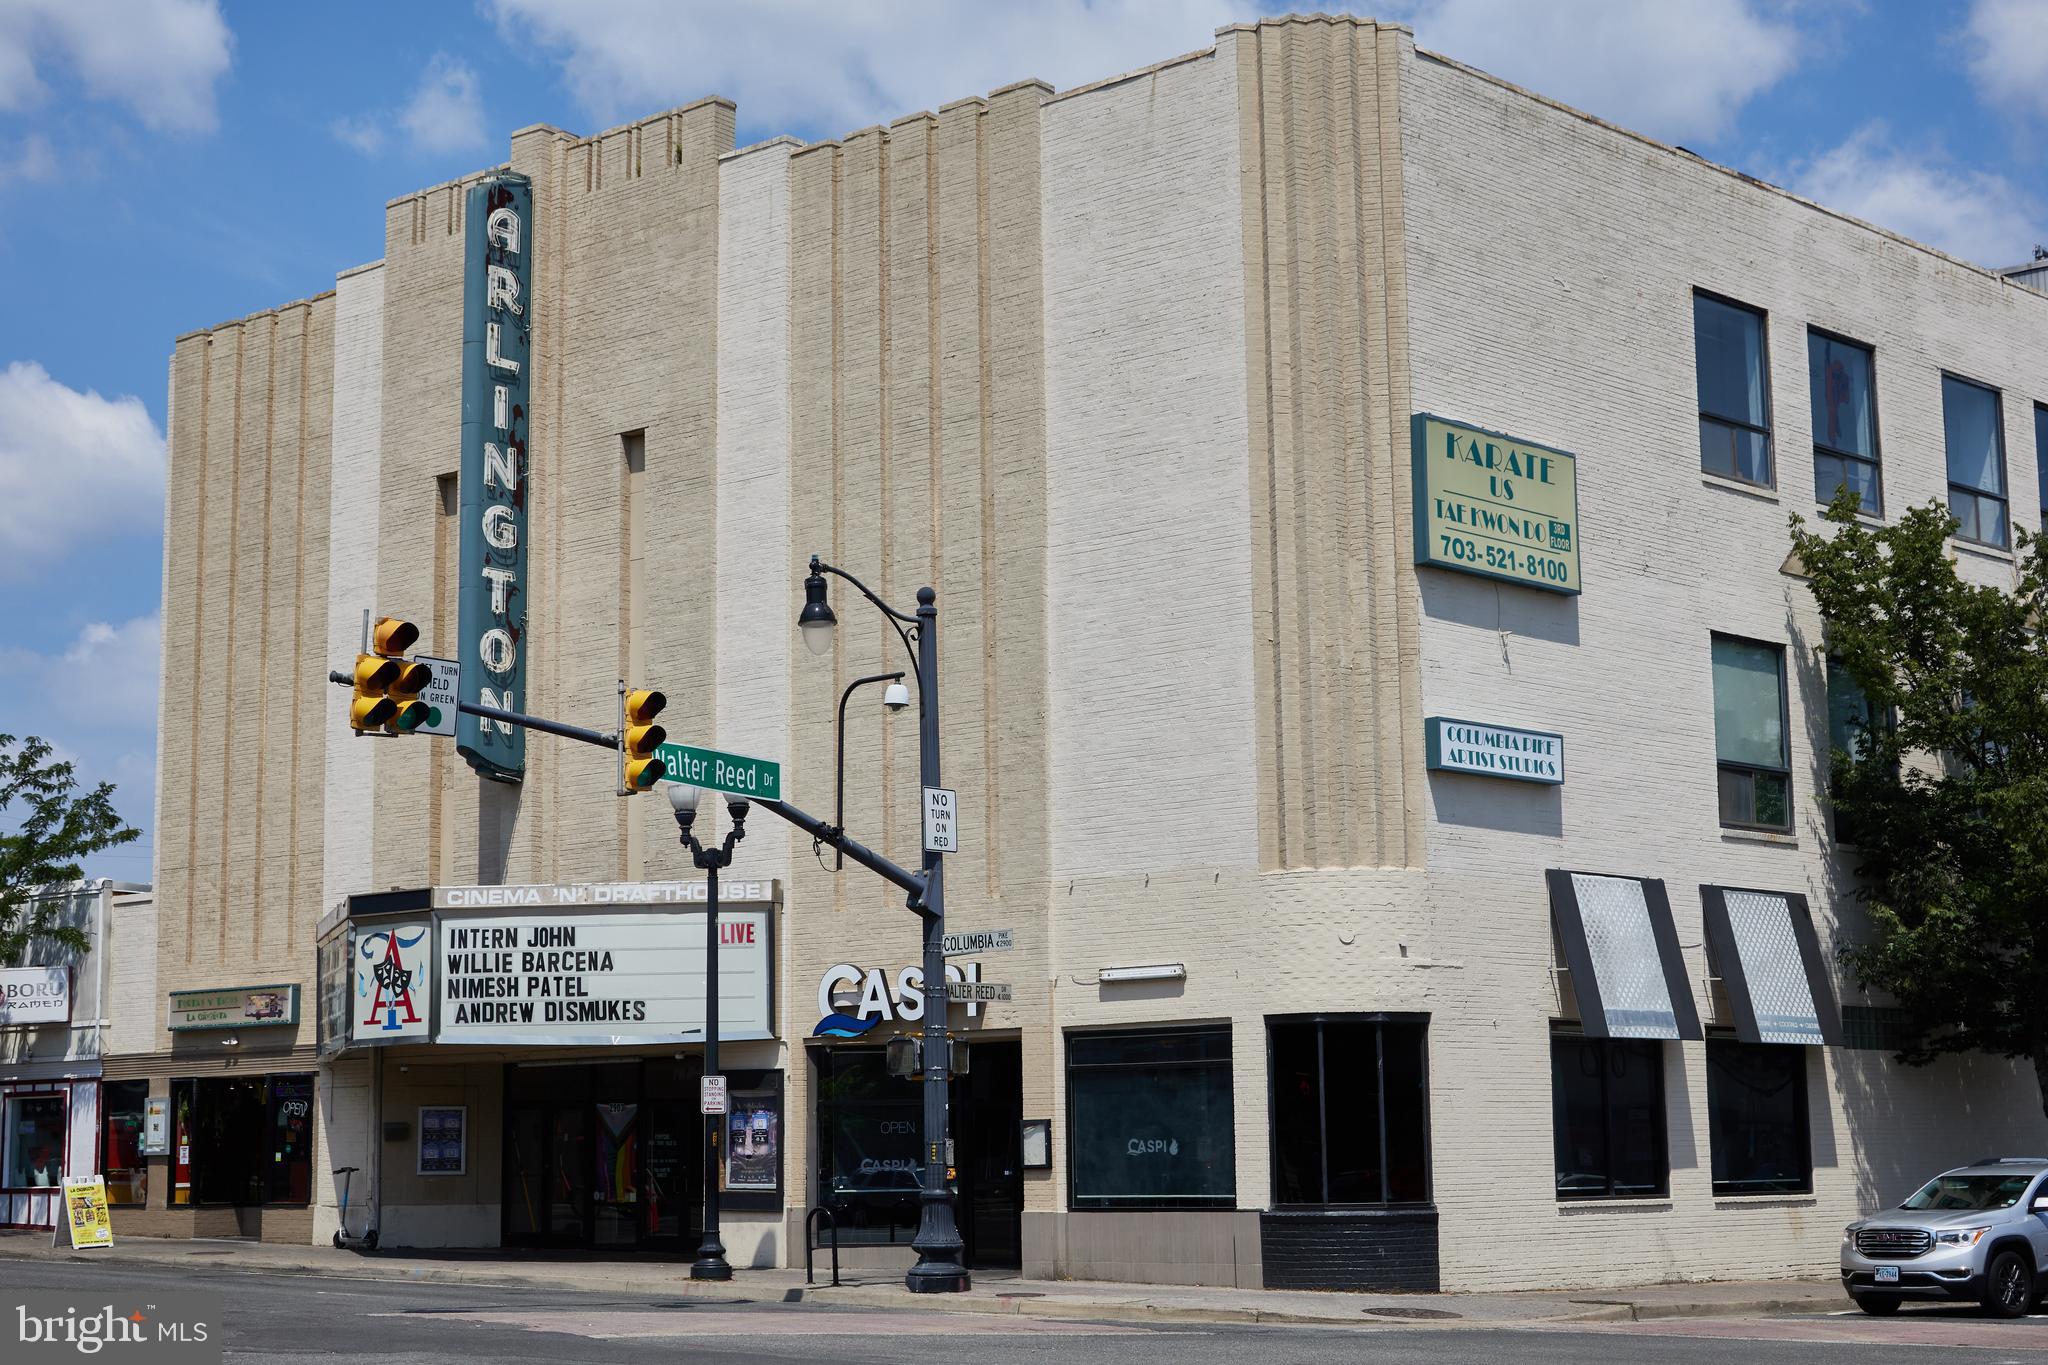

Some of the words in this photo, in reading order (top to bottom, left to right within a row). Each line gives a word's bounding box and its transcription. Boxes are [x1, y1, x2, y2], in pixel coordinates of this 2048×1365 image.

[1446, 432, 1556, 486] KARATE
[479, 208, 523, 738] ARLINGTON
[1490, 476, 1514, 500] US
[1434, 498, 1467, 525] TAE
[1471, 507, 1520, 537] KWON
[1524, 520, 1547, 543] DO
[1553, 523, 1566, 535] 3RD
[1550, 537, 1570, 550] FLOOR
[440, 665, 458, 676] TURN
[428, 677, 449, 690] IELD
[429, 692, 455, 704] GREEN
[1447, 726, 1520, 751] COLUMBIA
[1522, 737, 1555, 756] PIKE
[1447, 748, 1496, 768] ARTIST
[1499, 754, 1556, 776] STUDIOS
[715, 760, 756, 791] Reed
[763, 773, 774, 787] Dr
[932, 793, 947, 806] NO
[931, 809, 950, 820] TURN
[935, 823, 946, 833] ON
[934, 836, 948, 847] RED
[447, 887, 542, 905] CINEMA
[450, 928, 518, 949] INTERN
[527, 926, 576, 948] JOHN
[721, 923, 755, 944] LIVE
[944, 934, 994, 952] COLUMBIA
[448, 952, 513, 974] WILLIE
[522, 951, 614, 973] BARCENA
[7, 983, 63, 998] BORU
[448, 977, 519, 999] NIMESH
[527, 976, 588, 998] PATEL
[975, 985, 995, 1000] REED
[7, 1000, 63, 1009] RAMEN
[455, 1002, 534, 1024] ANDREW
[545, 1000, 646, 1022] DISMUKES
[282, 1101, 308, 1116] OPEN
[880, 1121, 916, 1134] OPEN
[1126, 1139, 1167, 1154] CASPI
[860, 1159, 905, 1172] CASPI
